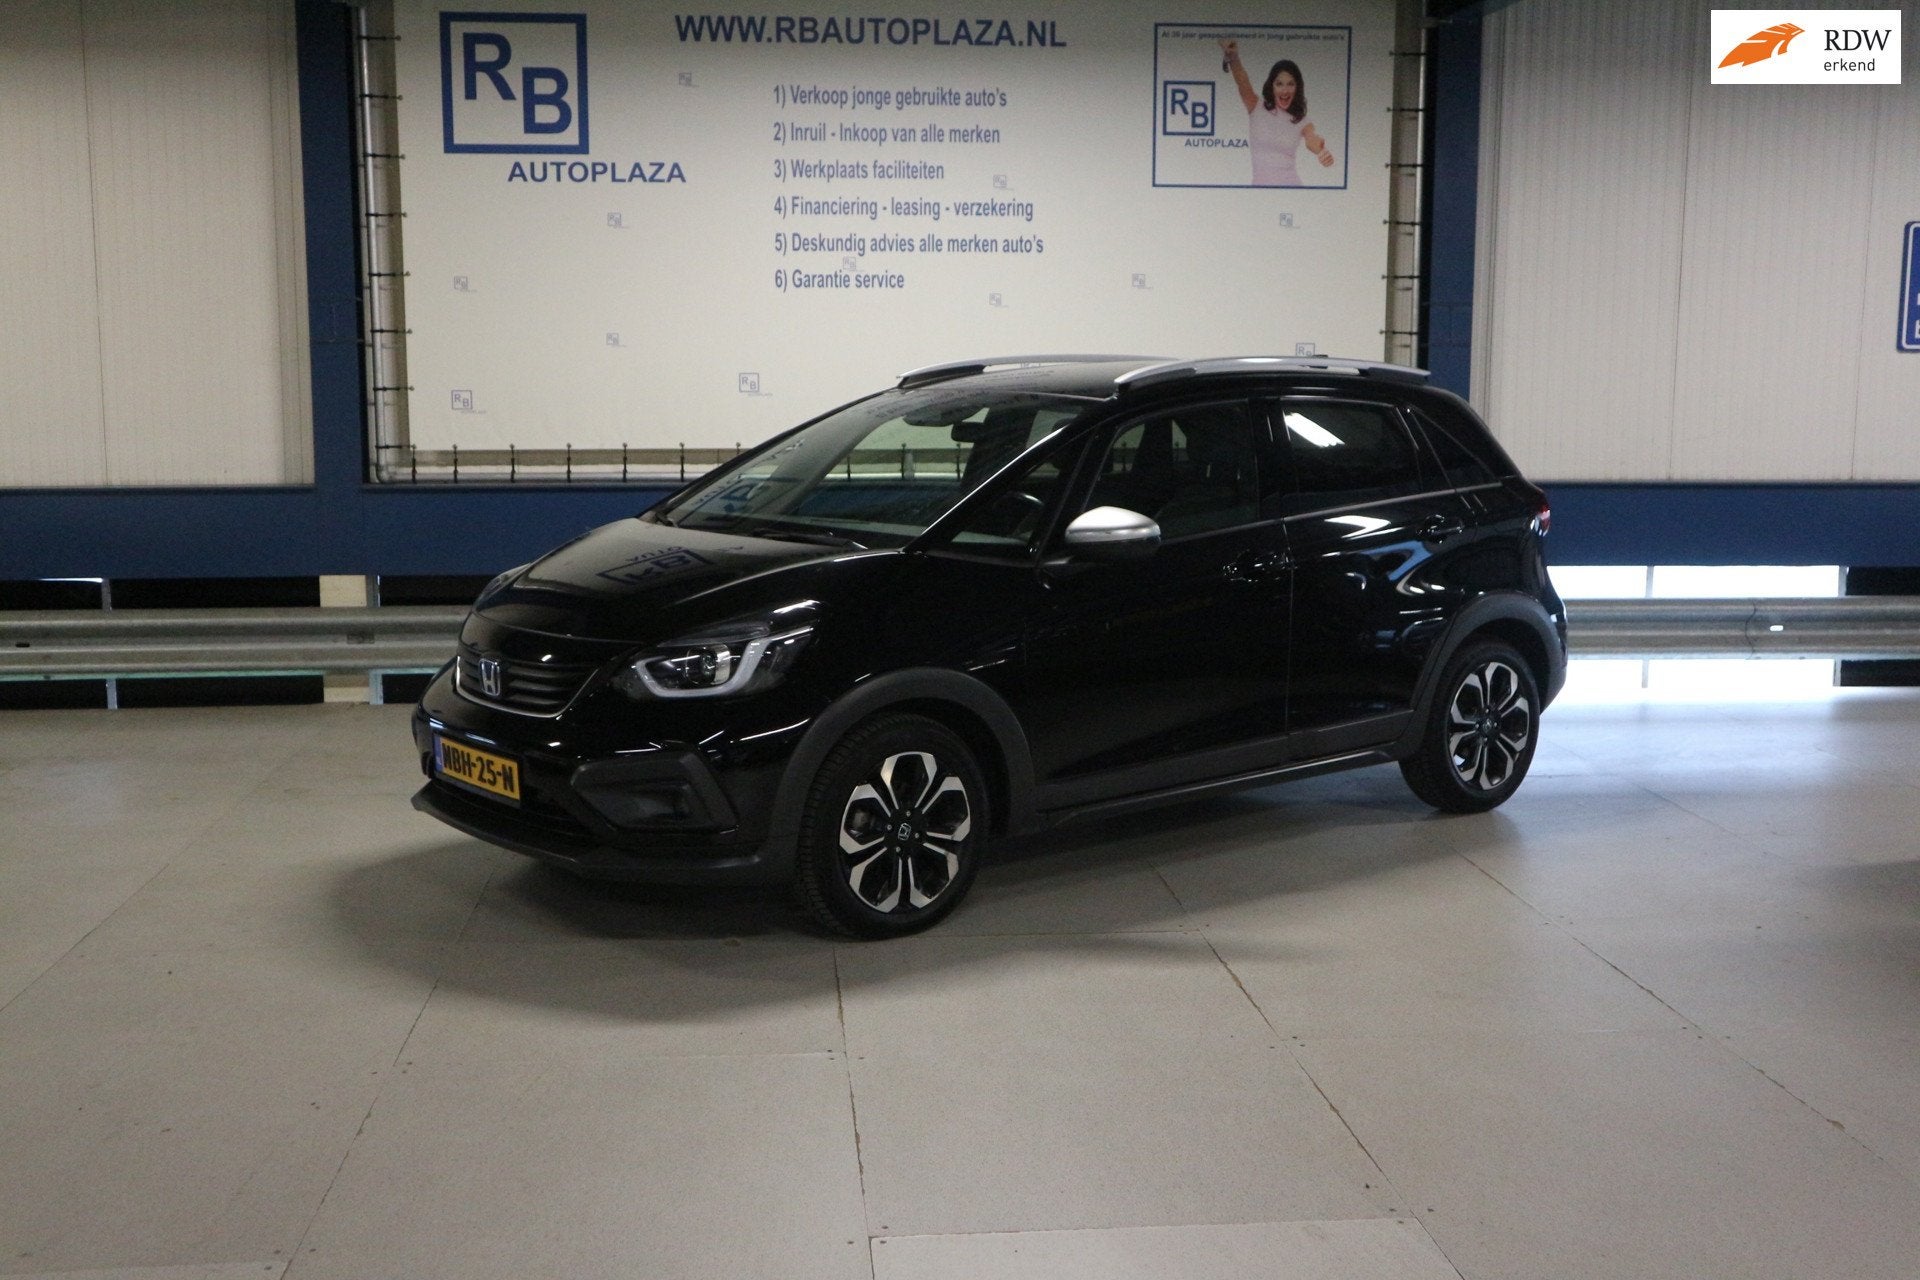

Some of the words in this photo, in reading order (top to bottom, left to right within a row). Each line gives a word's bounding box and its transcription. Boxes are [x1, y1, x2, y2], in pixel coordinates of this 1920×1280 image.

[675, 15, 1067, 47] WWW.RBAUTOPLAZA.NL
[463, 33, 572, 134] RB
[774, 85, 786, 108] 1)
[790, 85, 848, 109] Verkoop
[852, 86, 892, 110] jonge
[895, 87, 961, 111] gebruikte
[965, 88, 1007, 107] auto's
[1171, 89, 1209, 129] RB
[773, 121, 786, 145] 2)
[790, 122, 826, 142] Inruil
[839, 123, 887, 146] Inkoop
[892, 127, 916, 143] van
[921, 124, 944, 143] alle
[949, 125, 1000, 144] merken
[1184, 136, 1249, 148] AUTOPLAZA
[508, 161, 686, 183] AUTOPLAZA
[774, 158, 787, 182] 3)
[790, 159, 869, 182] Werkplaats
[873, 159, 945, 180] faciliteiten
[774, 195, 787, 219] 4)
[791, 196, 878, 220] Financiering
[891, 197, 941, 221] leasing
[954, 197, 1034, 223] verzekering
[774, 232, 787, 256] 5)
[791, 233, 865, 256] Deskundig
[870, 233, 915, 253] advies
[919, 234, 943, 253] alle
[947, 234, 998, 253] merken
[1002, 235, 1044, 254] auto's
[774, 269, 787, 293] 6)
[792, 269, 851, 289] Garantie
[855, 270, 905, 289] service
